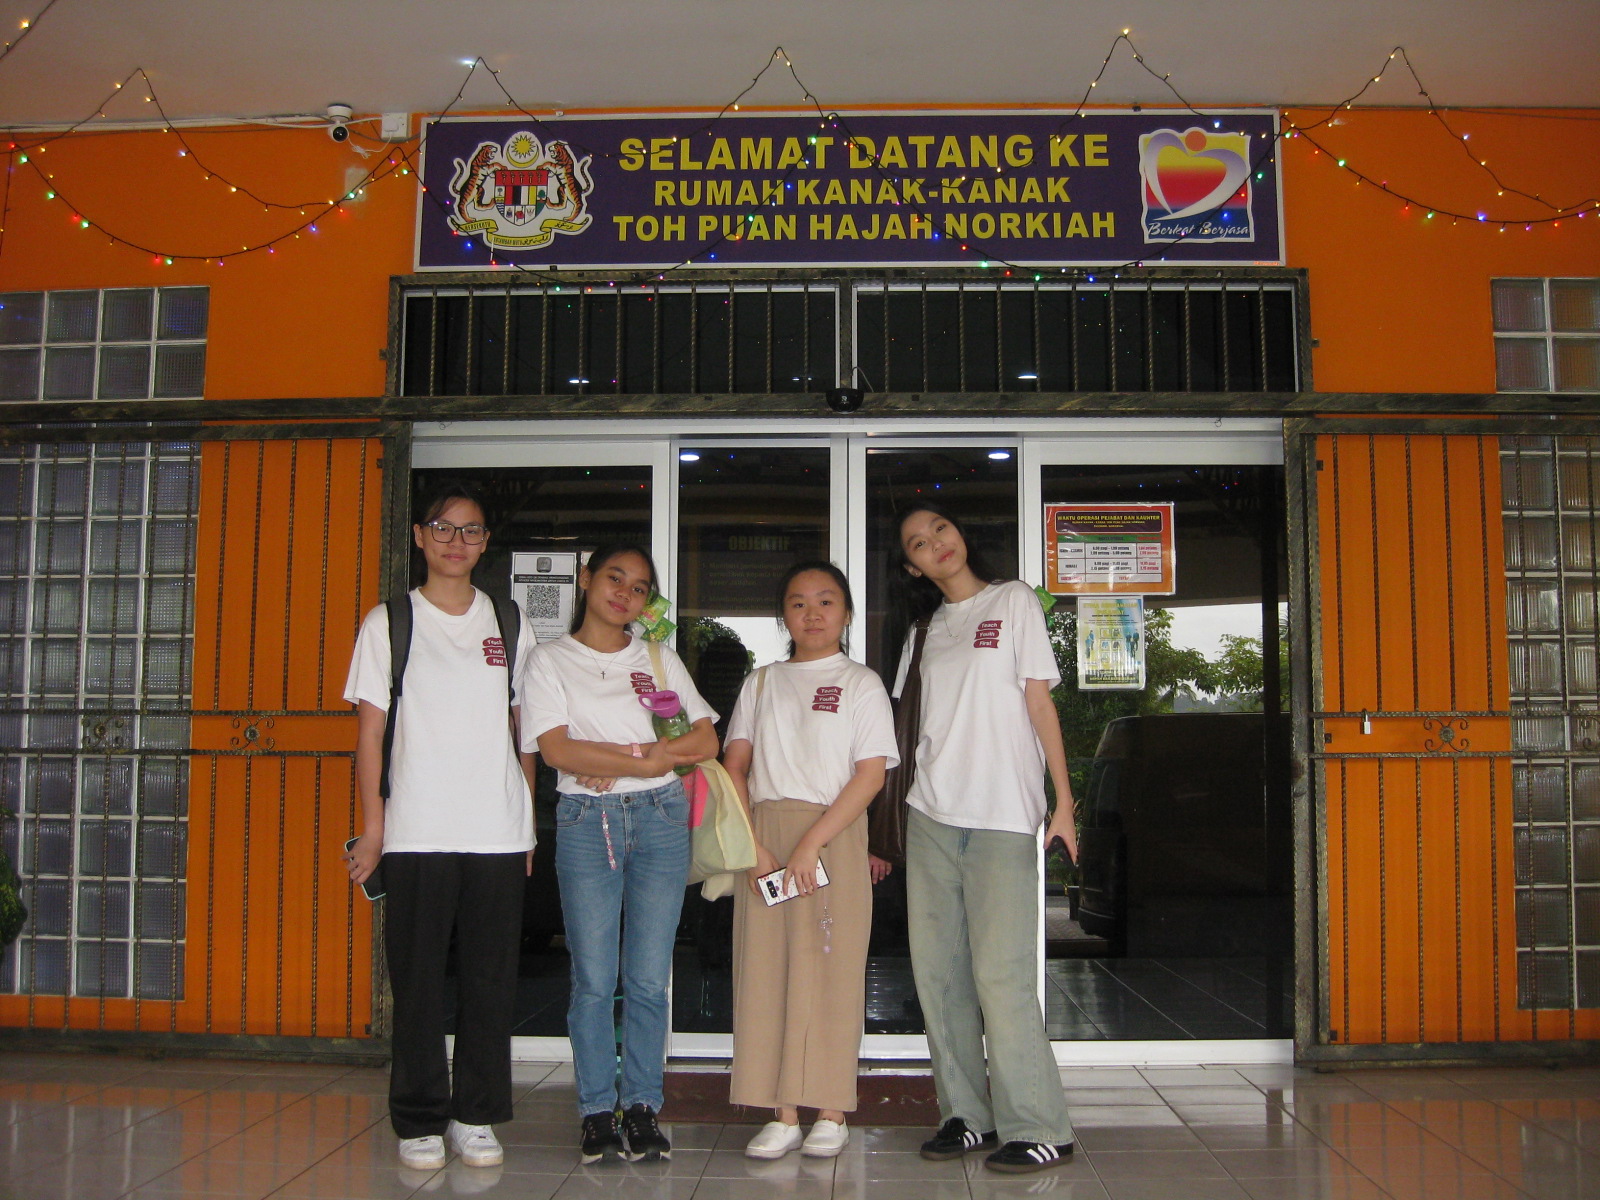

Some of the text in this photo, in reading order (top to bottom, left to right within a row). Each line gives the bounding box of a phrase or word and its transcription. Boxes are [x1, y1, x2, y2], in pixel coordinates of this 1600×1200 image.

[619, 134, 1109, 171] SELAMAT DATANG KE
[654, 176, 1071, 206] RUMAH KANAK-KANAK
[612, 212, 1115, 242] TOH PUAN HAJAH NORKIAH
[1148, 221, 1248, 238] Berkat Berjasa
[728, 535, 790, 551] OBJEKTIF
